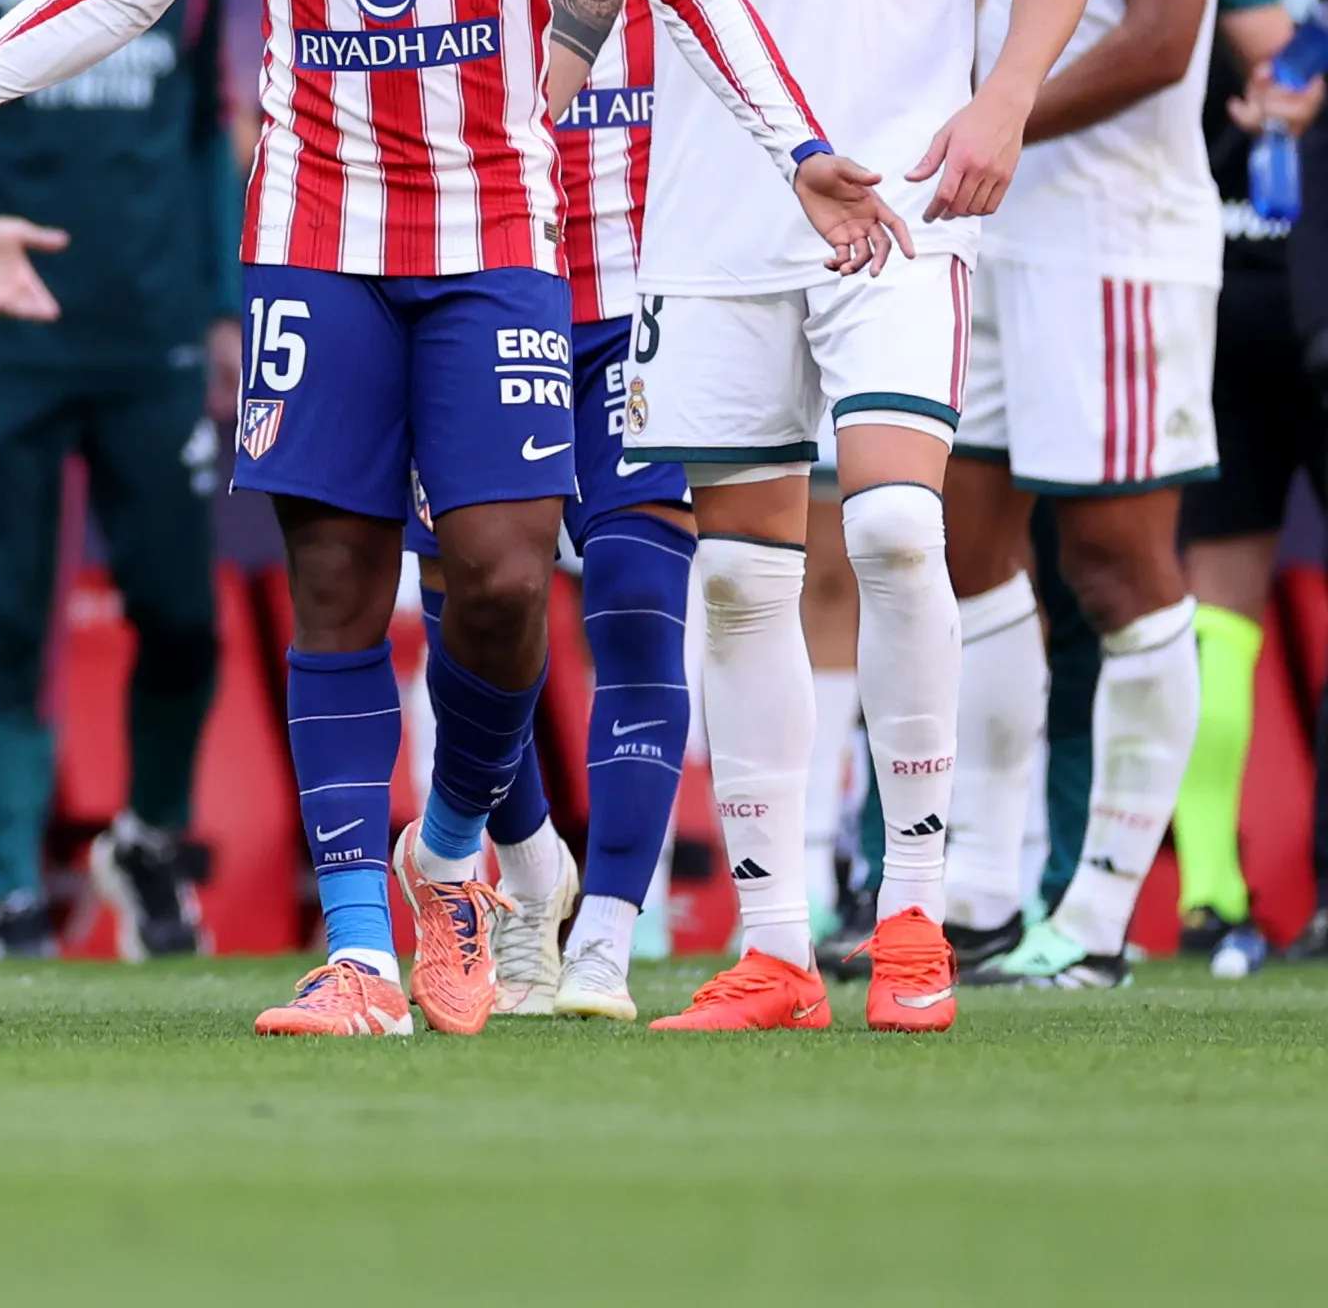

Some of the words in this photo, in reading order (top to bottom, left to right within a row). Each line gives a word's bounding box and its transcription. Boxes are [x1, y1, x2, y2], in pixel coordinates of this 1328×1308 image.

[300, 30, 427, 67] RIYADH
[435, 22, 496, 61] AIR
[248, 297, 312, 393] 15
[496, 328, 570, 365] ERGO
[499, 377, 572, 410] DKV
[323, 847, 364, 863] ATLETI
